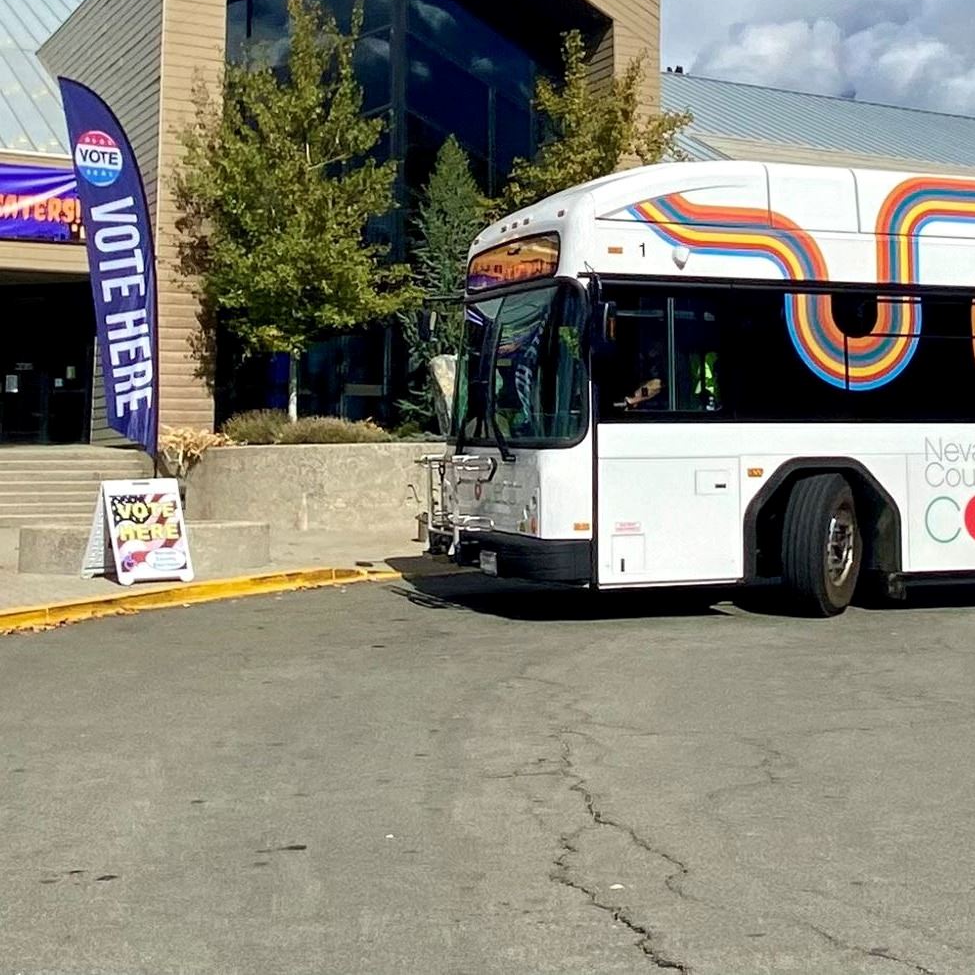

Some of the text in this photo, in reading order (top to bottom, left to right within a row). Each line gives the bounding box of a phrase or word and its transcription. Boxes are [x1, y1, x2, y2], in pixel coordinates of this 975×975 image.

[79, 147, 118, 166] VOTE
[639, 242, 645, 257] 1
[90, 196, 153, 418] VOTE HERE
[117, 503, 174, 520] VOTE
[121, 524, 178, 540] HERE
